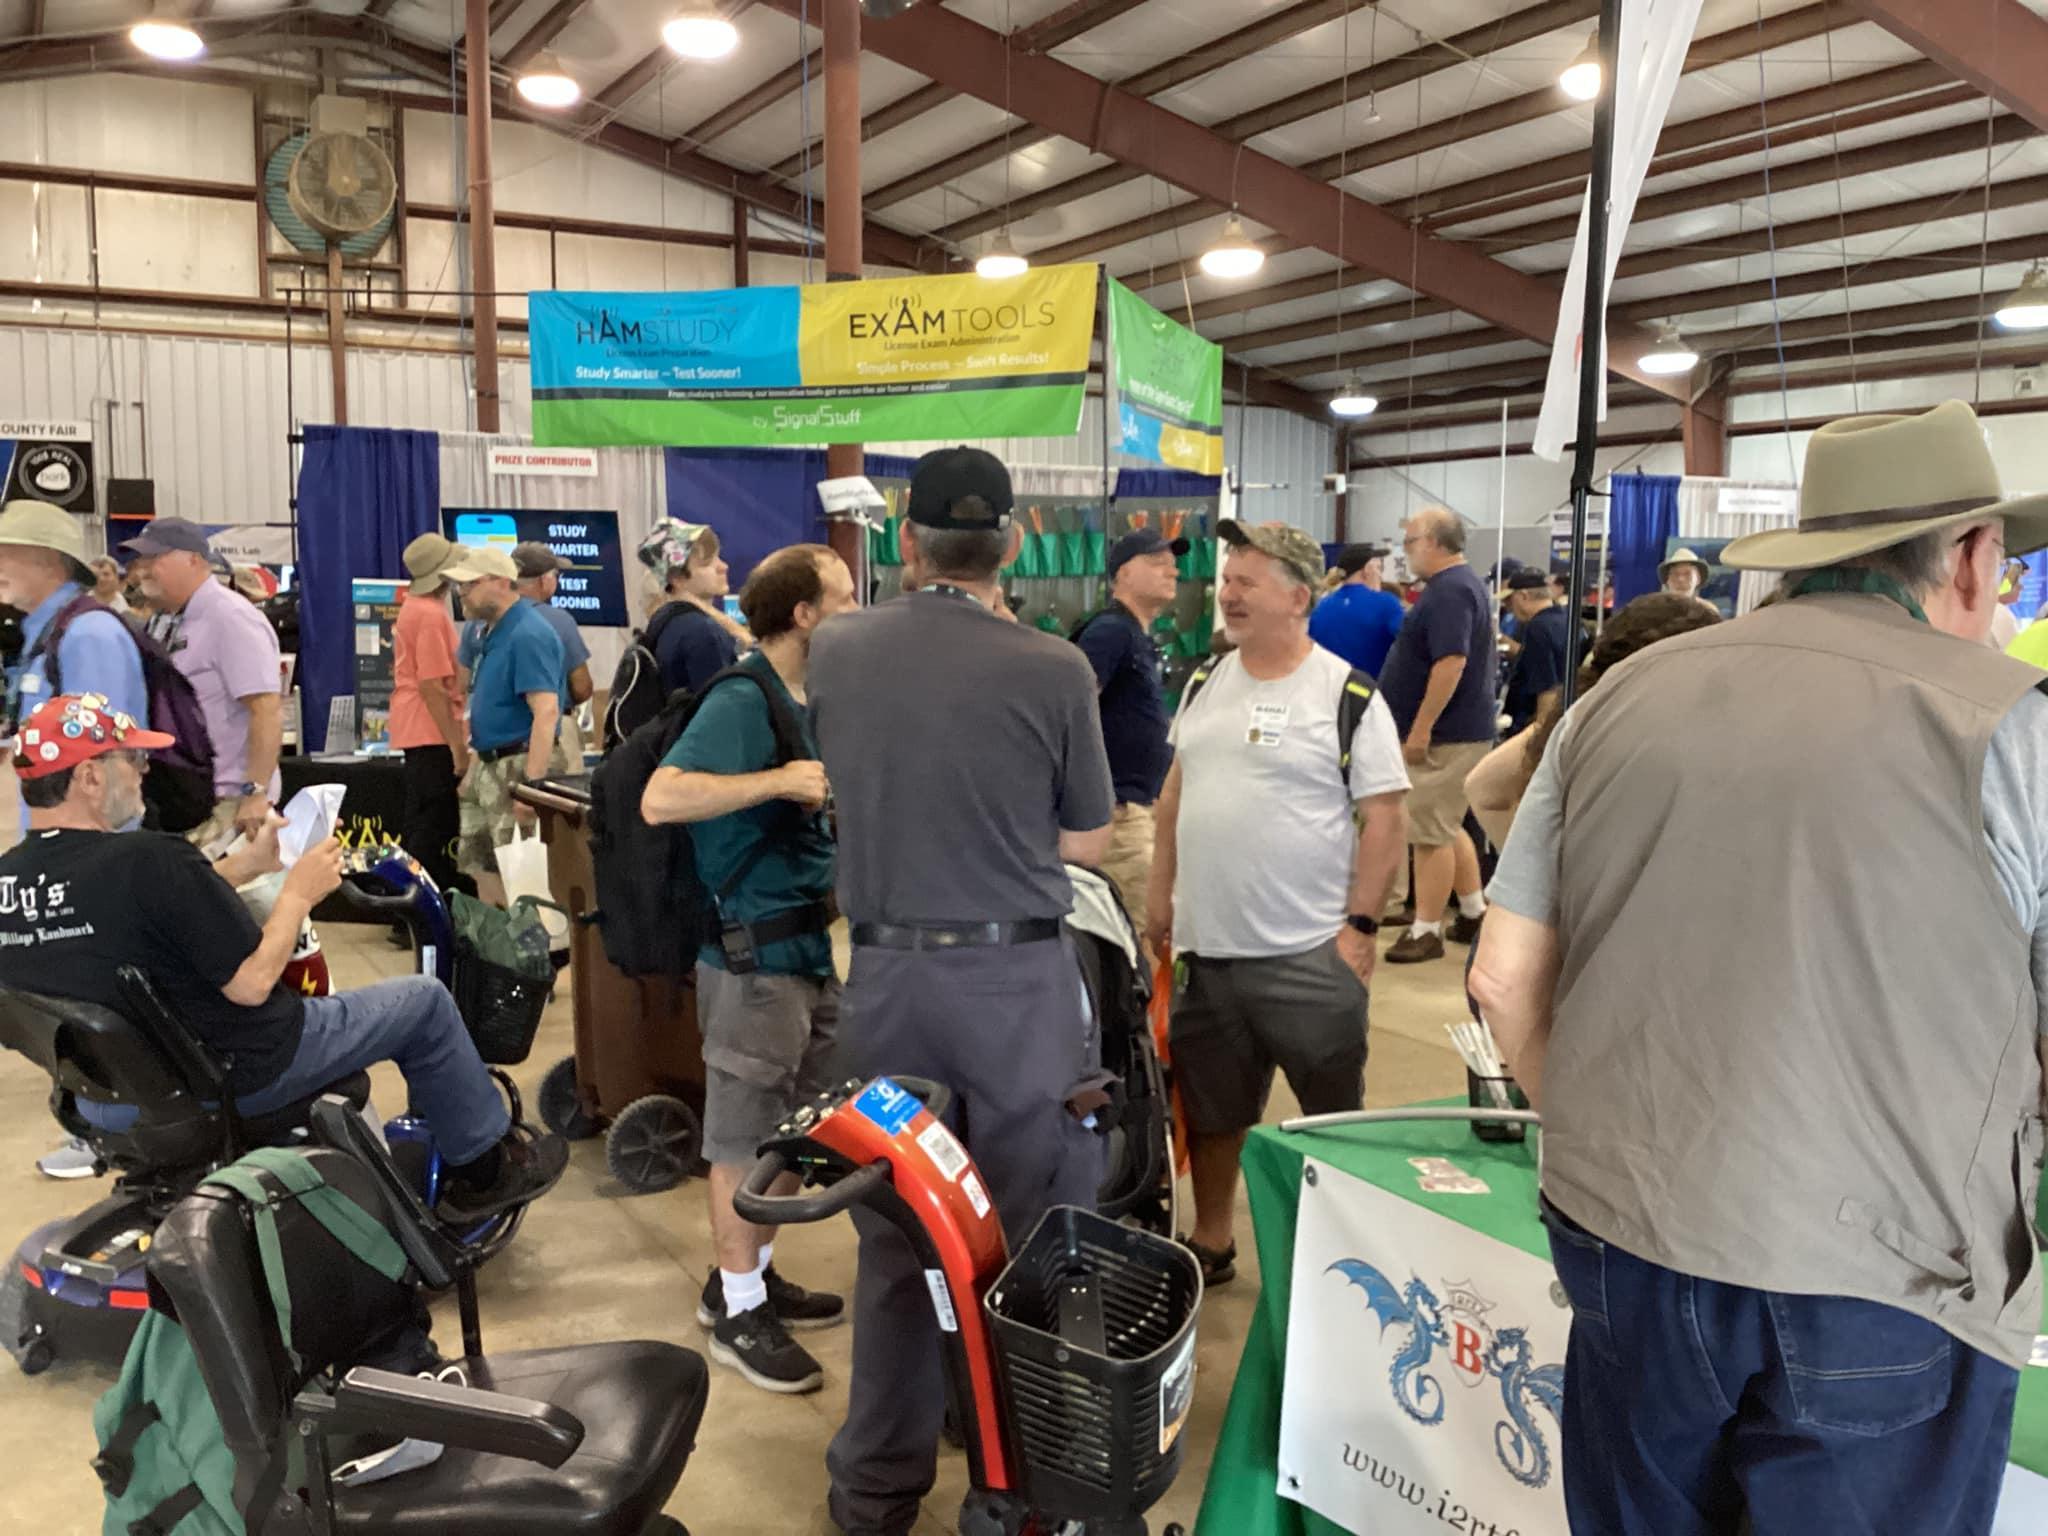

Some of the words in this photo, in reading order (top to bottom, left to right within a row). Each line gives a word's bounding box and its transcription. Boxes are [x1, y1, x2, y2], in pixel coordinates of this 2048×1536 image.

[920, 338, 949, 350] Exam
[857, 361, 898, 376] Simple
[901, 358, 950, 373] Process
[966, 353, 996, 369] Swift
[1000, 351, 1050, 366] Results!
[576, 366, 610, 381] Study
[613, 366, 659, 380] Smarter
[672, 366, 696, 380] Test
[697, 366, 741, 380] Sooner!
[753, 415, 768, 429] by
[49, 424, 77, 436] FAIR
[495, 455, 524, 465] PRIZE
[526, 456, 592, 468] CONTRIBUTOR
[548, 524, 587, 538] STUDY
[546, 543, 599, 557] MARTER
[558, 577, 588, 591] TEST
[550, 597, 600, 610] SOONER
[1452, 1320, 1482, 1375] B
[1343, 1442, 1520, 1536] www.i2rt
